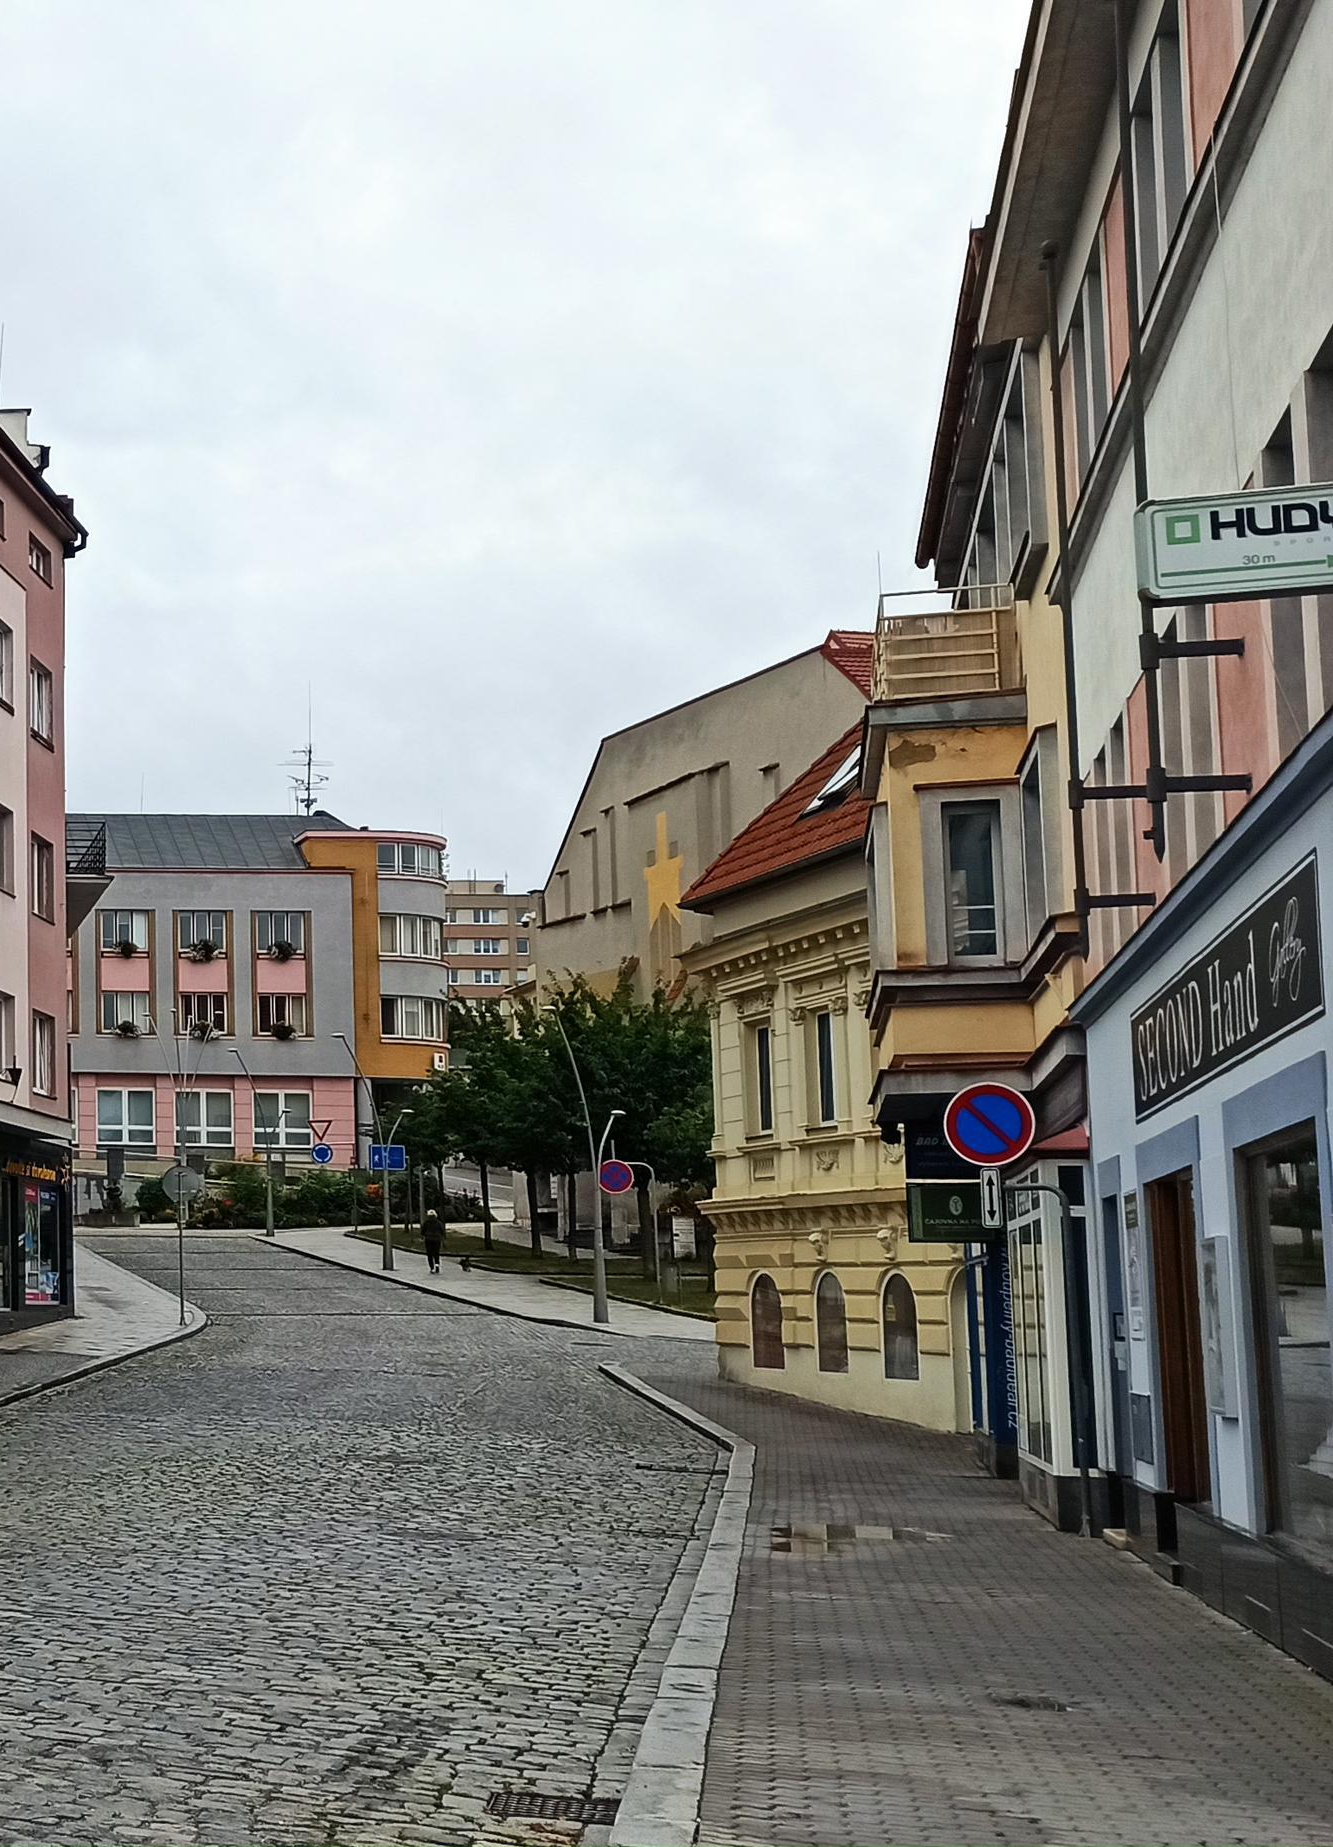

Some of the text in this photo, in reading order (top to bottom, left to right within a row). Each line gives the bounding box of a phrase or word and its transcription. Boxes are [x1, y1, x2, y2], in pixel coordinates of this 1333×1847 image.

[1242, 554, 1260, 565] 30
[1137, 929, 1259, 1101] SECOND Hand
